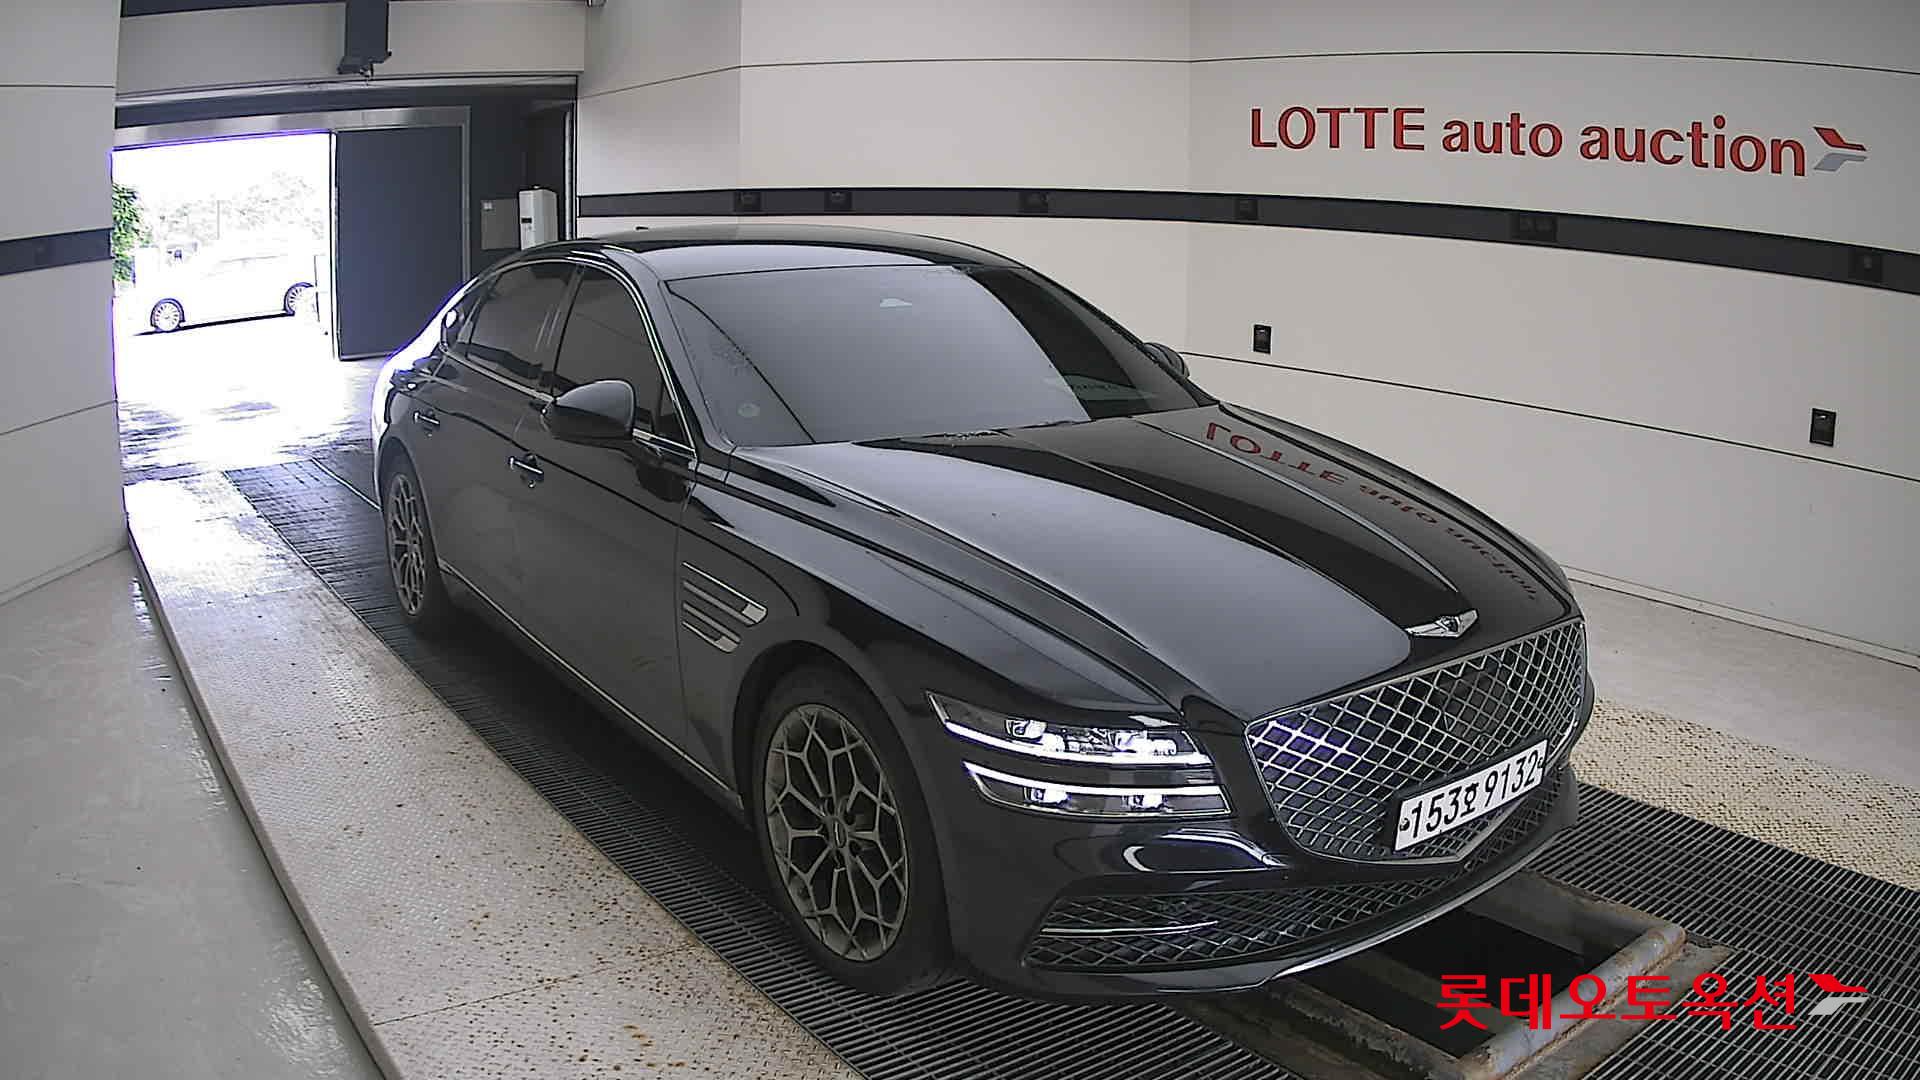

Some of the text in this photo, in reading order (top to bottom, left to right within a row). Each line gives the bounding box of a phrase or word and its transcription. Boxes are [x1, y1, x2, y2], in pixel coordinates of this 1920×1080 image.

[1251, 106, 1807, 178] LOTTE auto auction
[1411, 749, 1539, 839] 153호 9132
